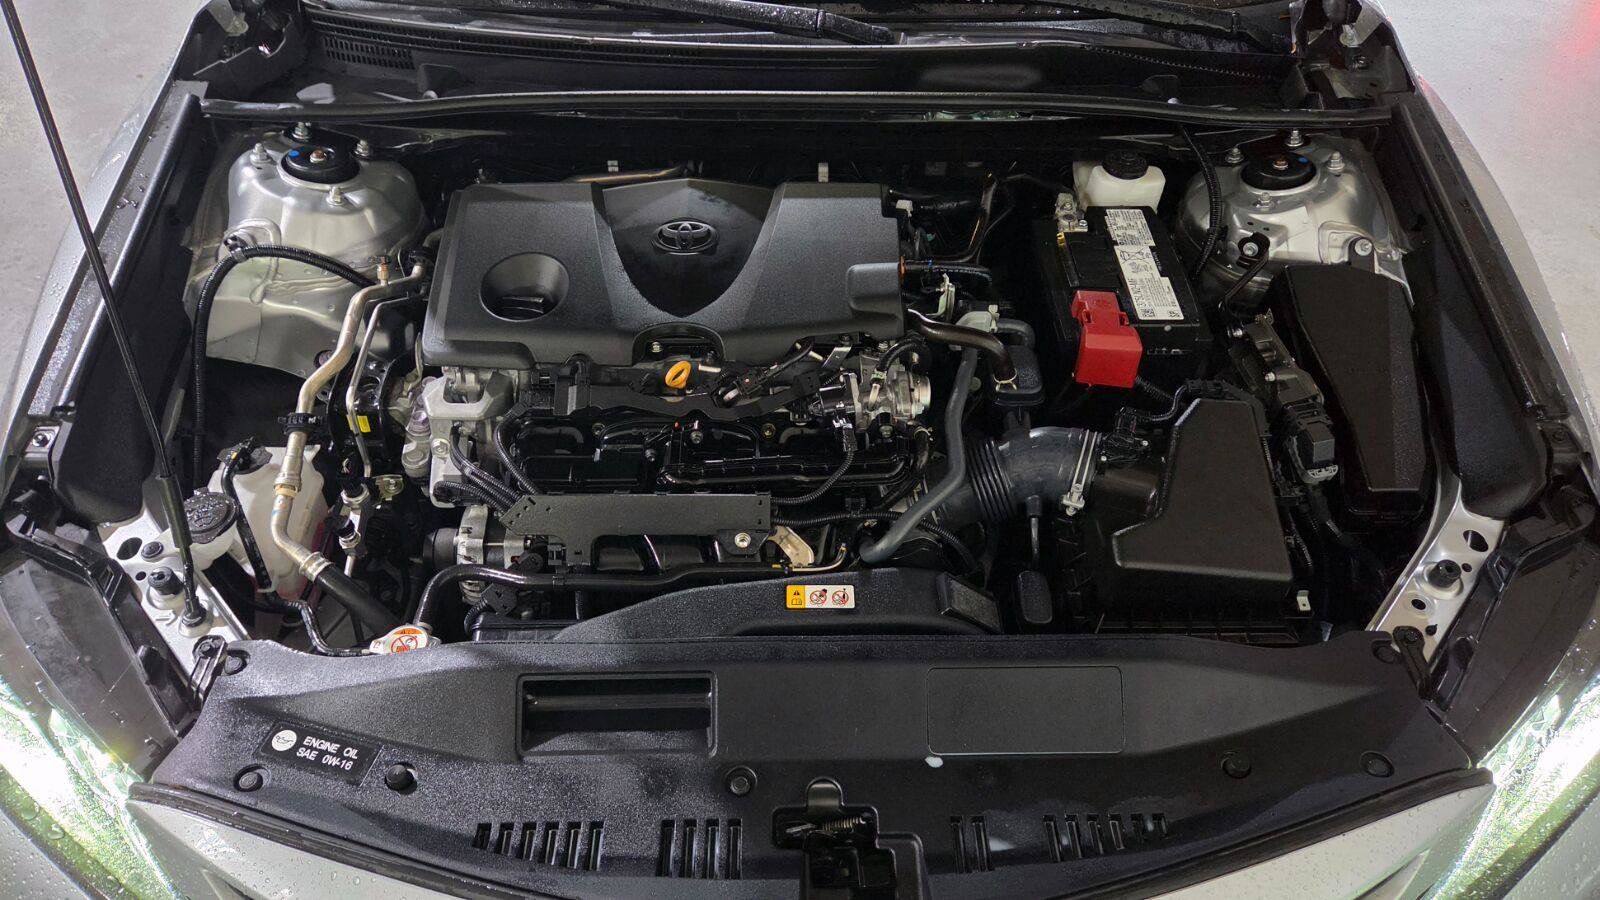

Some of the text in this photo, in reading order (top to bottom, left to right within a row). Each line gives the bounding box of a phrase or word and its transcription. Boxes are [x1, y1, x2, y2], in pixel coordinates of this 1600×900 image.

[296, 747, 354, 770] SAE 0W-16
[303, 736, 359, 760] ENGINE OIL
